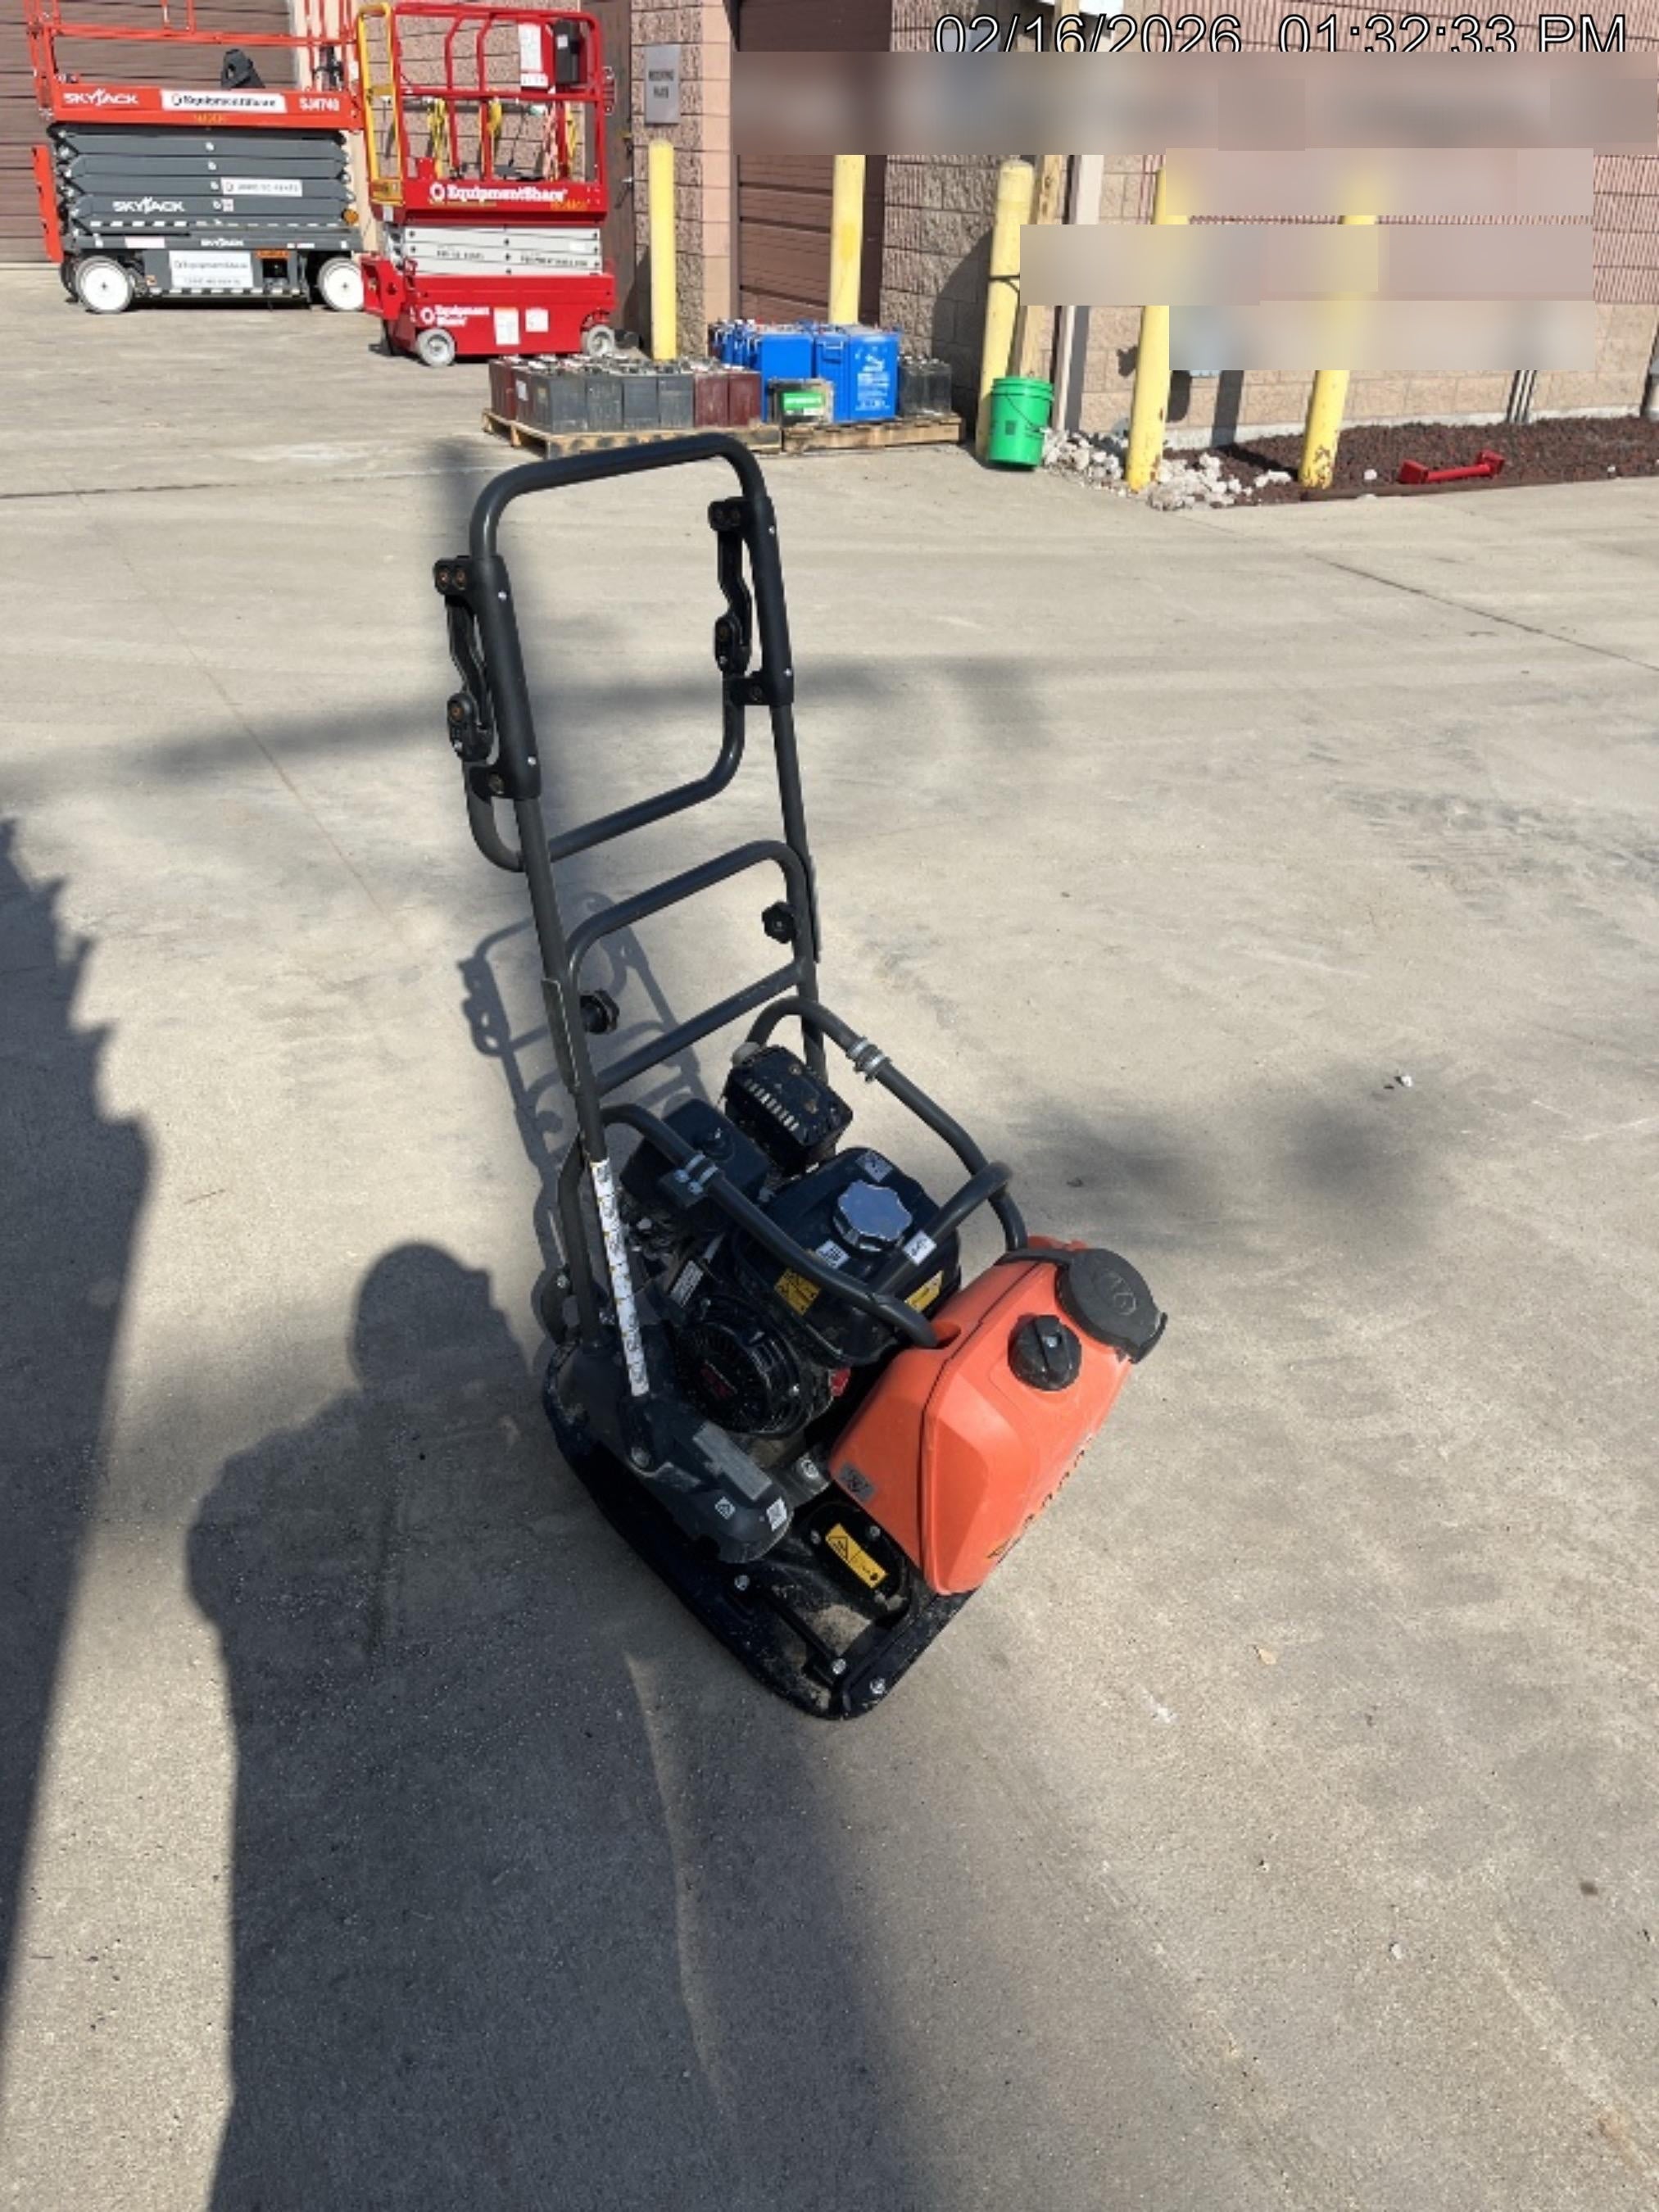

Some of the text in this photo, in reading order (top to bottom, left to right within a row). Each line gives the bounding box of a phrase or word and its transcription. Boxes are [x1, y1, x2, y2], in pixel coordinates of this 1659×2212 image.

[62, 88, 138, 107] SKYJACK
[446, 184, 565, 202] EquipmentShare
[112, 197, 185, 214] SKYJACK
